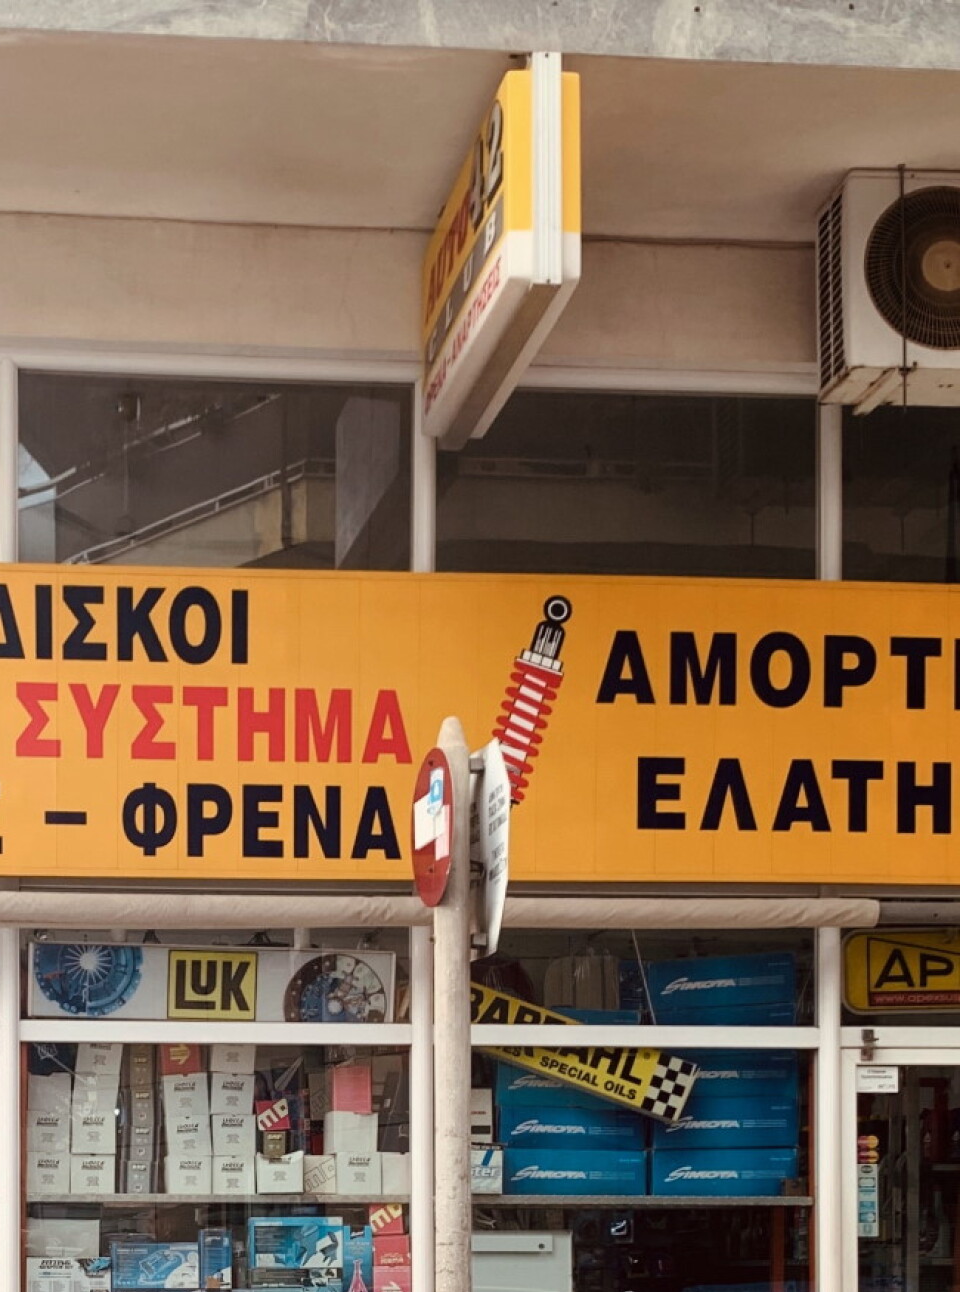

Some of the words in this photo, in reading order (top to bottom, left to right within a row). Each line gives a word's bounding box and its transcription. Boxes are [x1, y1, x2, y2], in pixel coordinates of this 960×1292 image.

[596, 630, 960, 710] ΑΜΟΡΤ
[16, 682, 413, 764] ΣΥΣΤΗΜΑ
[122, 783, 403, 861] ΦΡΕΝΑ
[637, 756, 952, 834] ΕΛΑΤΗ
[540, 1056, 598, 1086] SPECIAL
[604, 1080, 637, 1100] OILS
